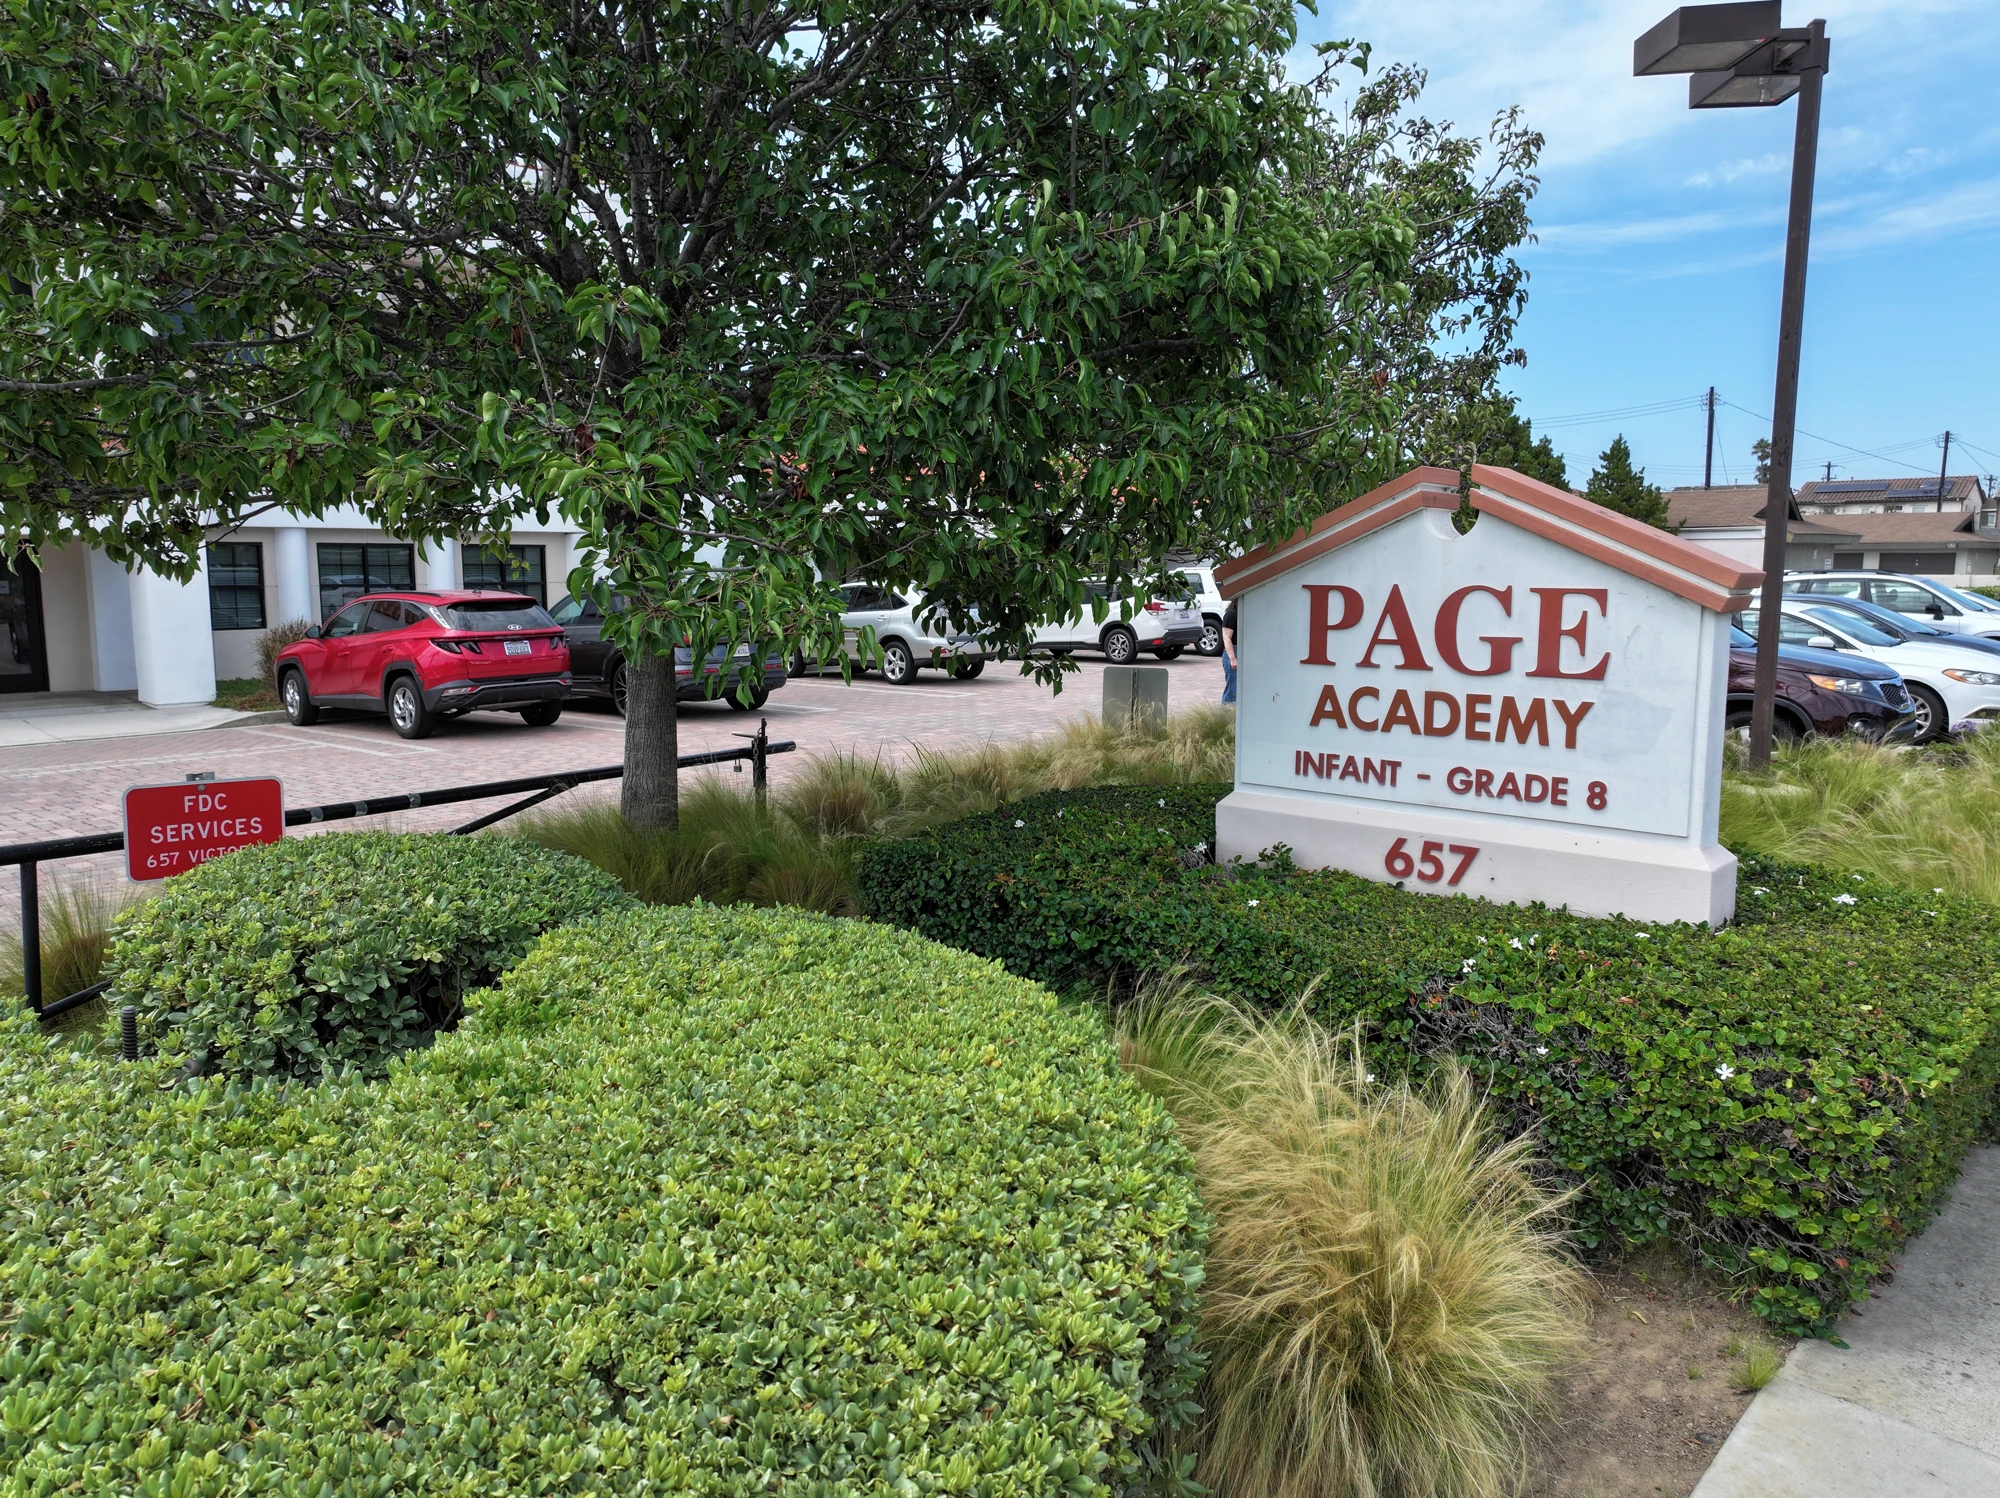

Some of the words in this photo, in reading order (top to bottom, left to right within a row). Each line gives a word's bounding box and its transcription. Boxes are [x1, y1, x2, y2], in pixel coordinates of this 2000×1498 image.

[1300, 583, 1611, 682] PAGE
[1309, 684, 1595, 750] ACADEMY
[184, 793, 227, 813] FDC
[1294, 749, 1402, 788] INFANT
[1446, 766, 1569, 807] GRADE
[1586, 780, 1608, 811] 8
[150, 817, 262, 844] SERVICES
[146, 851, 180, 869] 657
[1384, 837, 1479, 886] 657
